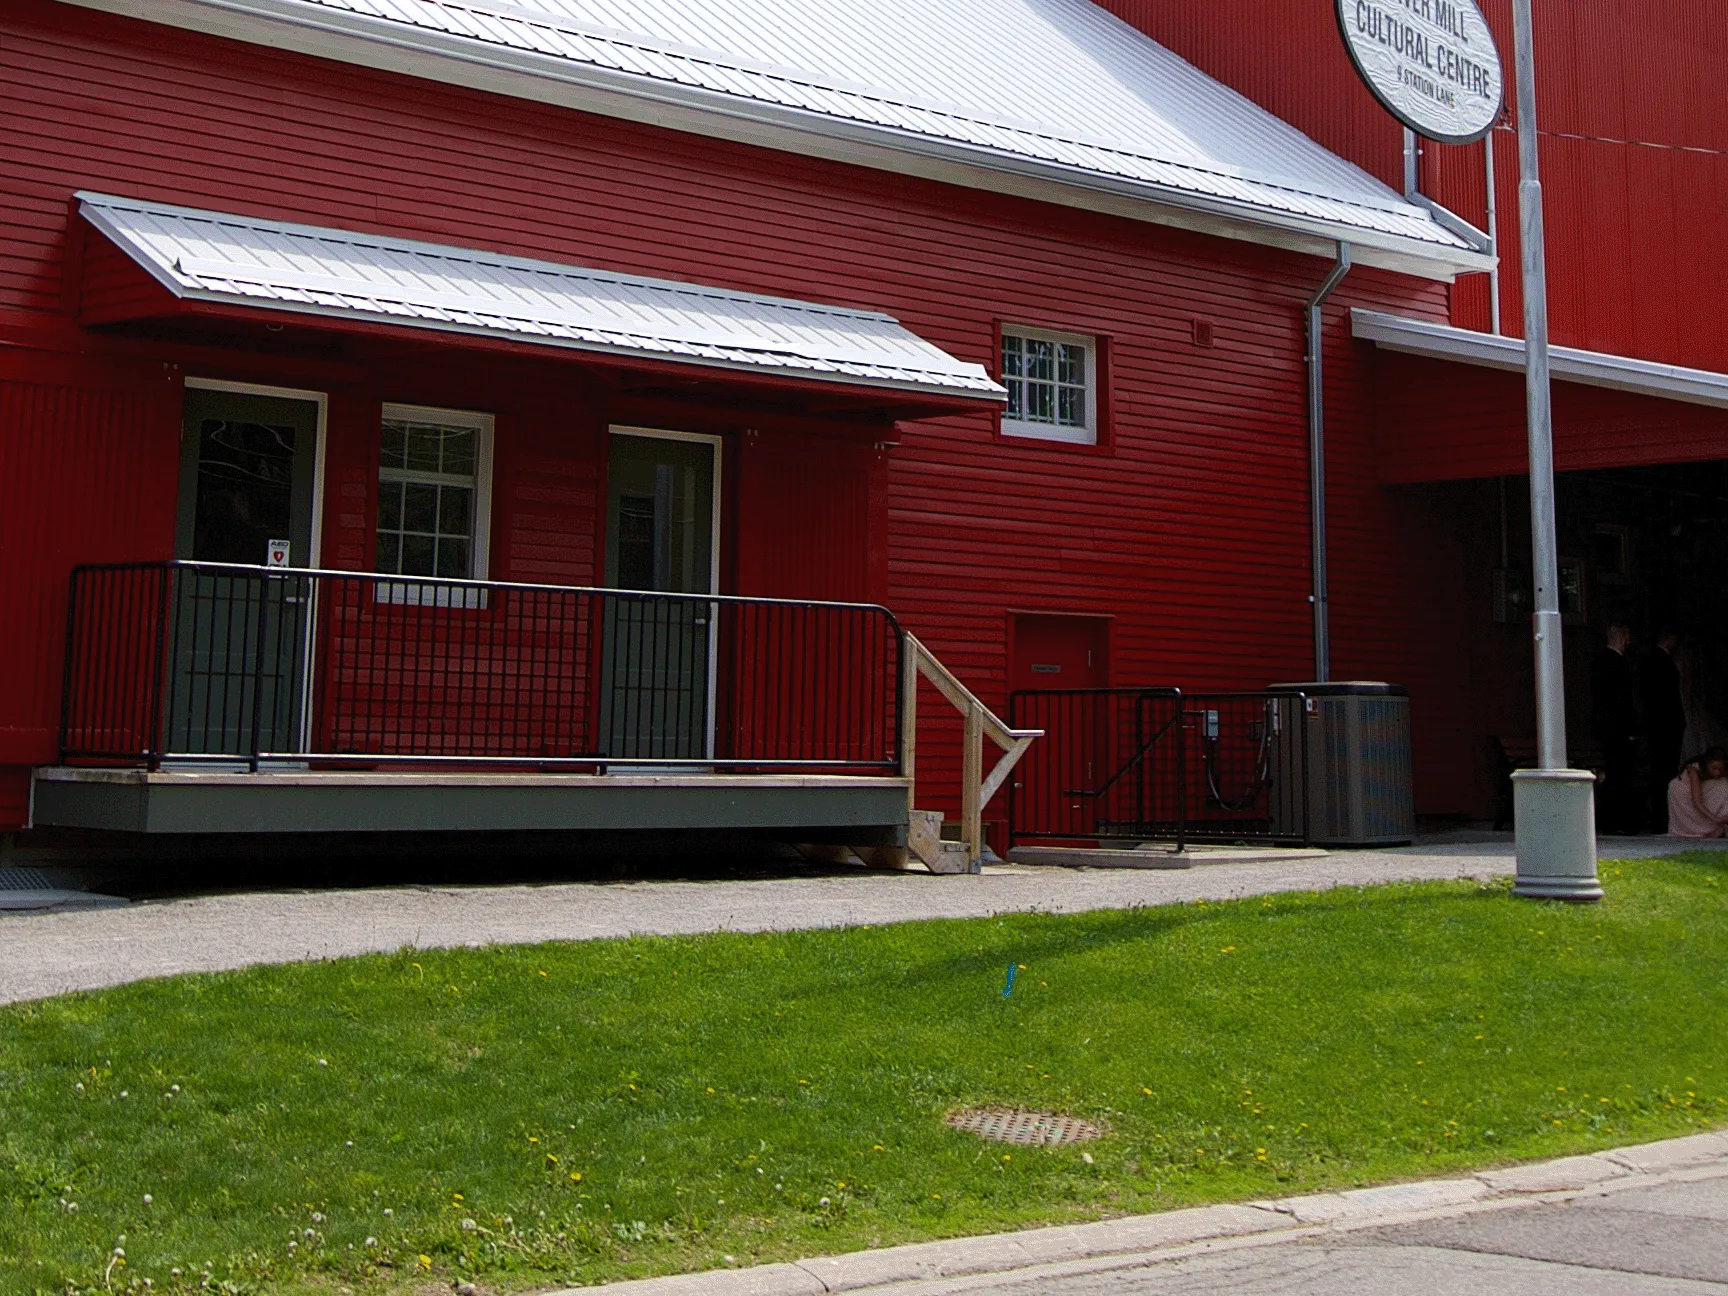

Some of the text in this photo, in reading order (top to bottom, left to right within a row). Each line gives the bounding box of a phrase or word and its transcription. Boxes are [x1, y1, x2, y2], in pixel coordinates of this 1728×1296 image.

[1356, 0, 1491, 99] CULTURAL CENTRE
[1404, 69, 1434, 99] STATION
[1436, 85, 1455, 108] LANE
